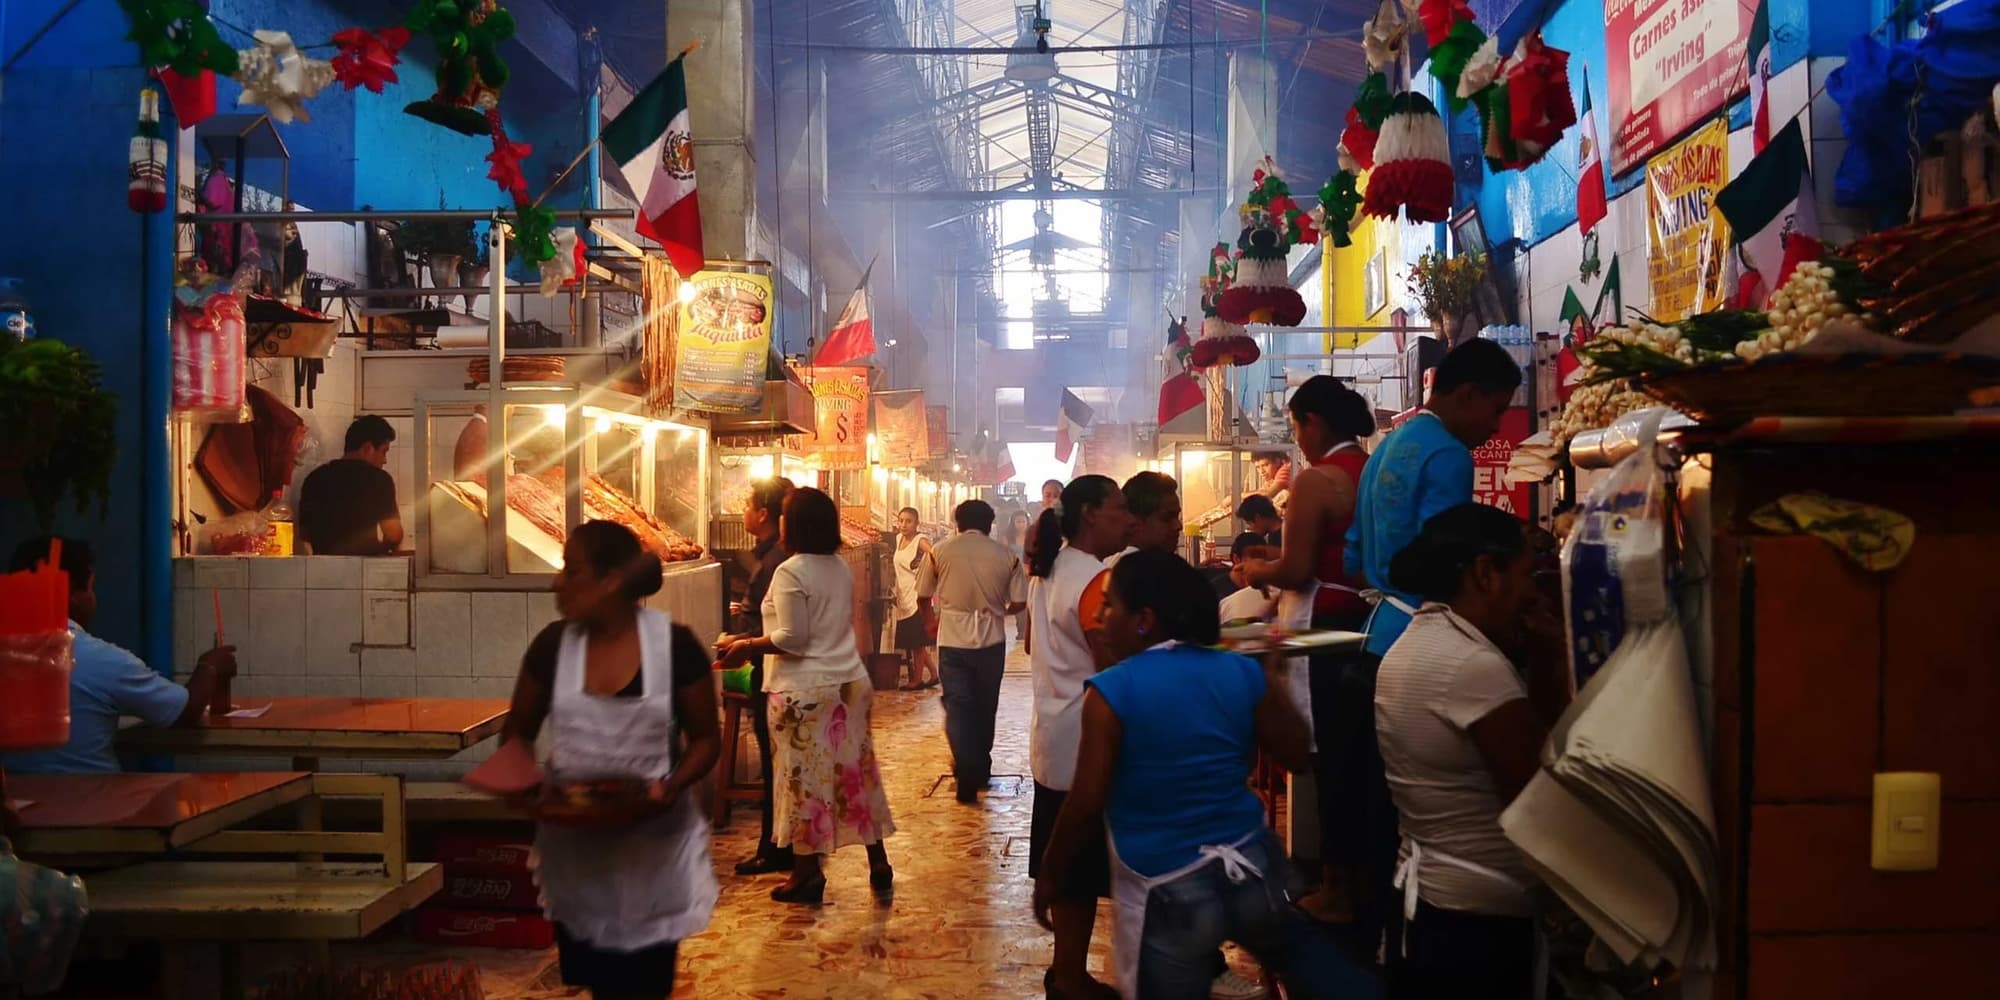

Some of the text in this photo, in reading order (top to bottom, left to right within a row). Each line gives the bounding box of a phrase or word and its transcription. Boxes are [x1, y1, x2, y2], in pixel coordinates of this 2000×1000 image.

[1633, 9, 1676, 60] Carnes
[1479, 439, 1511, 450] OSA
[1474, 467, 1516, 491] EN
